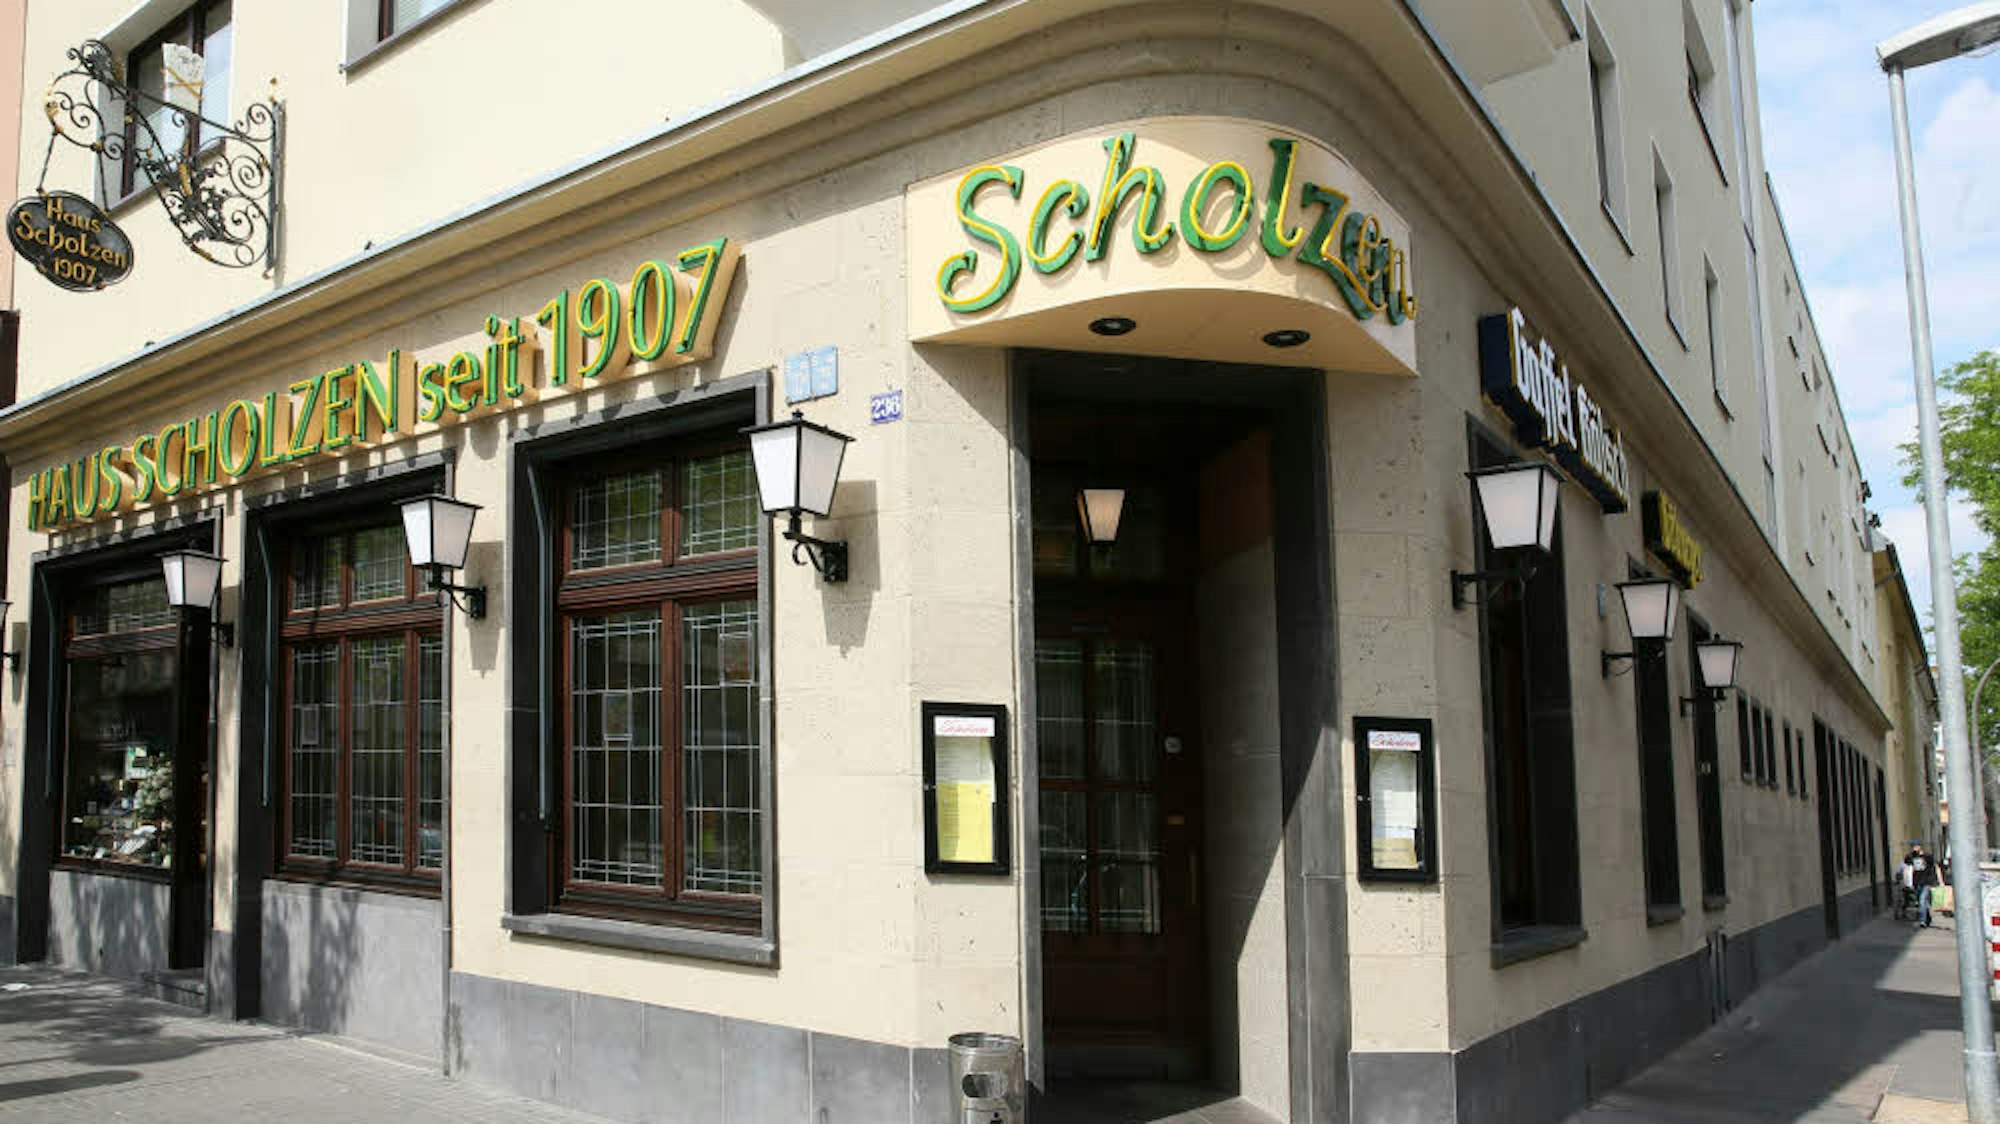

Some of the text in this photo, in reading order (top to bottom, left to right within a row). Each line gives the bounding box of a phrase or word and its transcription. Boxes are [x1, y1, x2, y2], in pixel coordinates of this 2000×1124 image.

[15, 210, 127, 269] Scholzen
[46, 197, 101, 234] Haus
[936, 131, 1417, 326] Scholzen
[53, 257, 97, 284] 1907
[27, 445, 121, 532] HAUS
[131, 349, 402, 503] SCHOLZEN
[418, 313, 525, 422] seit
[534, 237, 729, 388] 1907
[870, 395, 901, 419] 236
